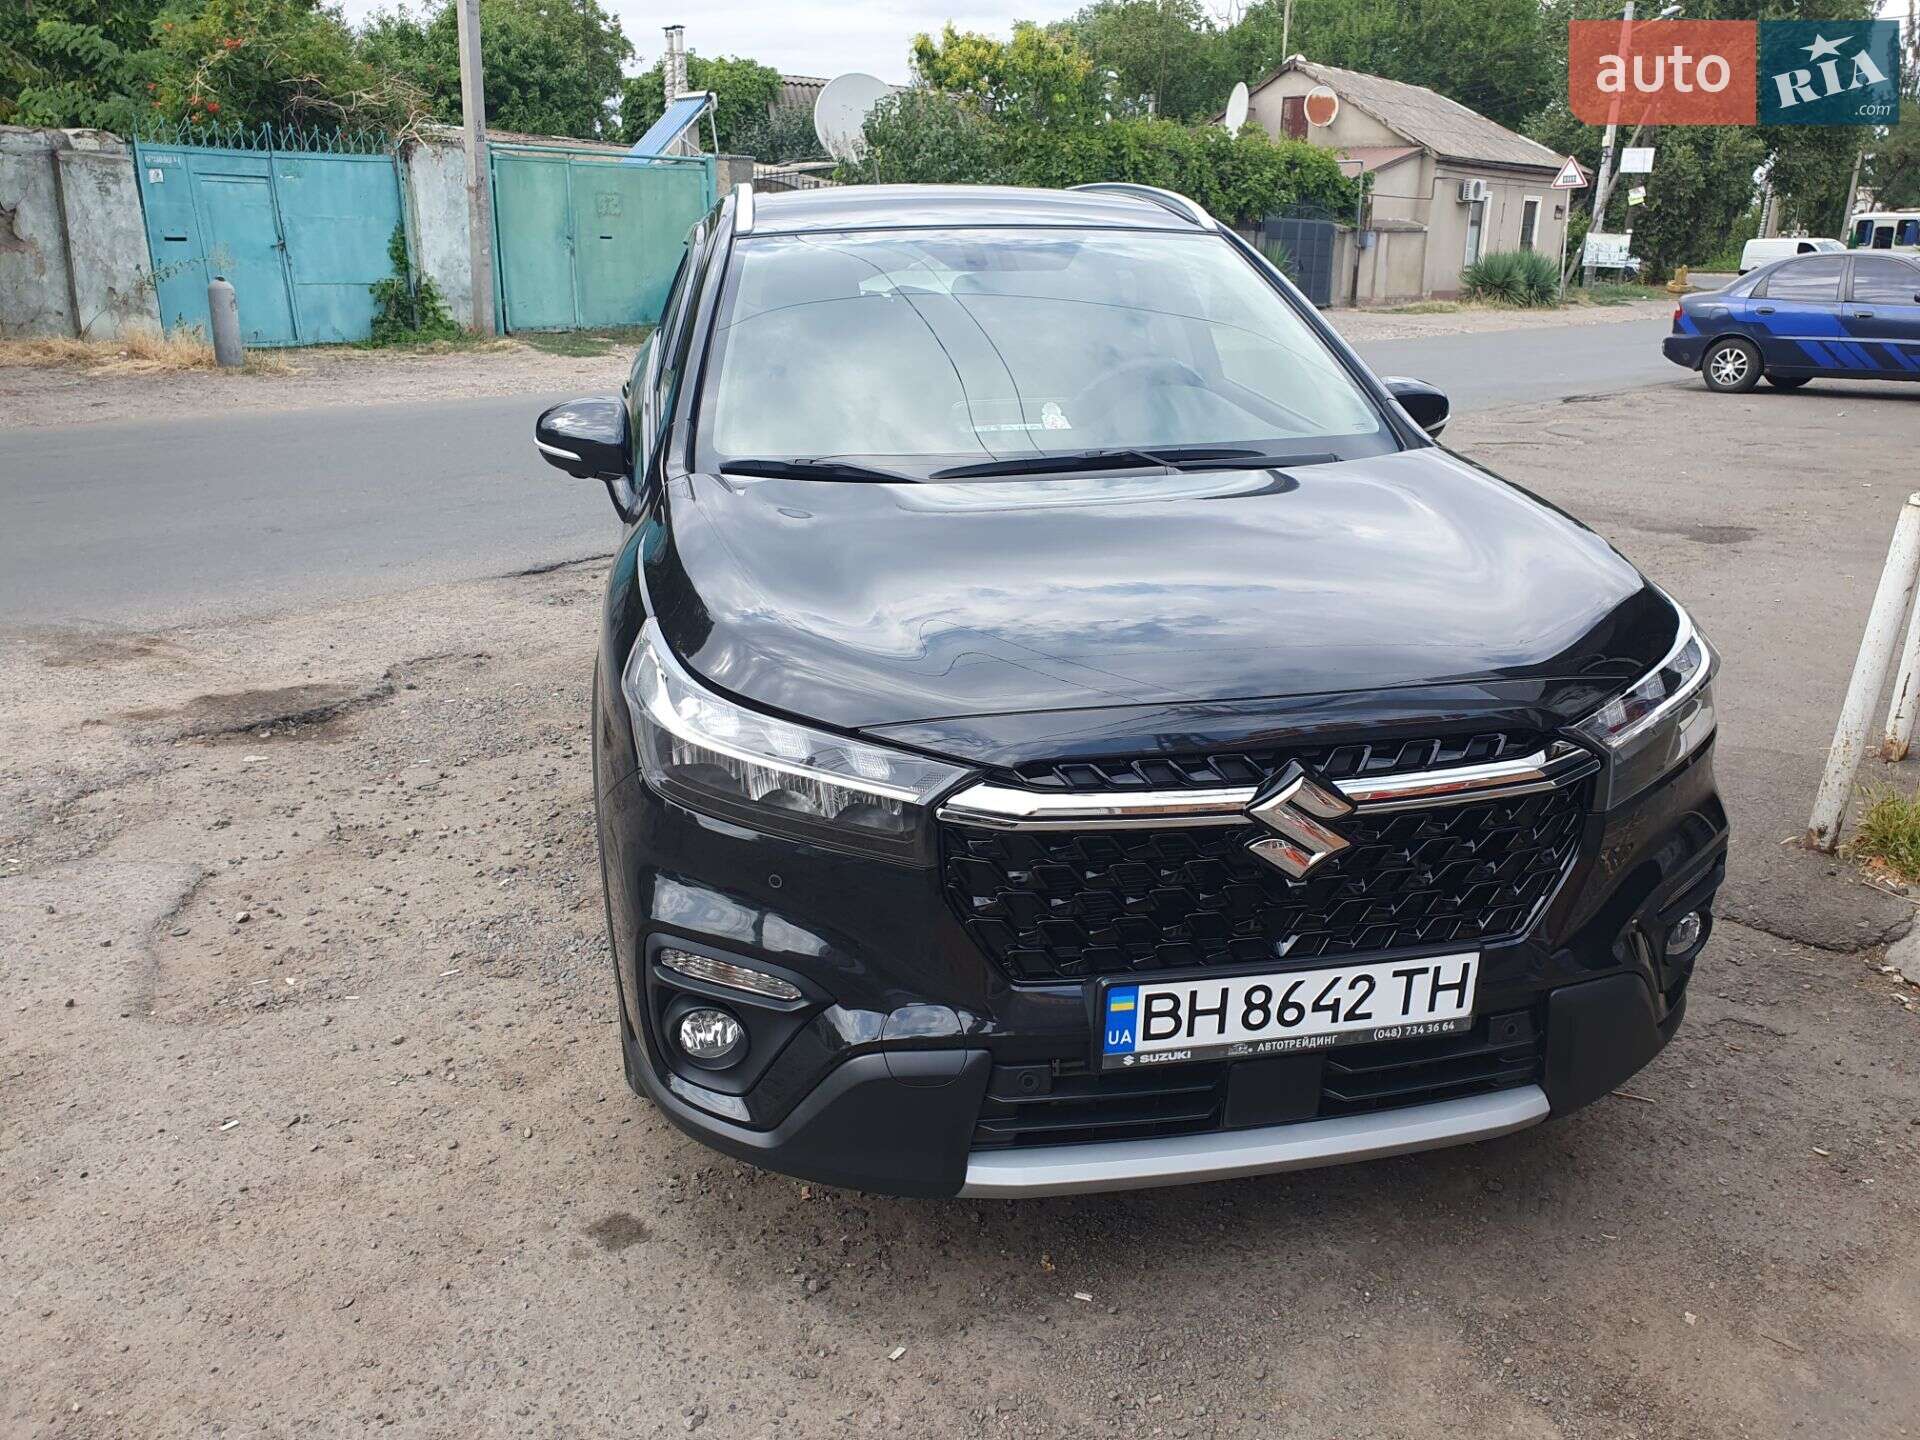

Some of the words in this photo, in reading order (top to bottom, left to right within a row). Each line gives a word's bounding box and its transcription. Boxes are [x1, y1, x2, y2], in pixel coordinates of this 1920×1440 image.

[1240, 973, 1376, 1031] 8642
[1107, 1029, 1132, 1045] UA
[1373, 1025, 1402, 1041] (048)
[1405, 1024, 1425, 1036] 734
[1428, 1022, 1440, 1033] 36
[1442, 1020, 1455, 1031] 64
[1257, 1034, 1338, 1052] АВТОТРЕЙДИНГ
[1139, 1050, 1192, 1063] SUZUKI
